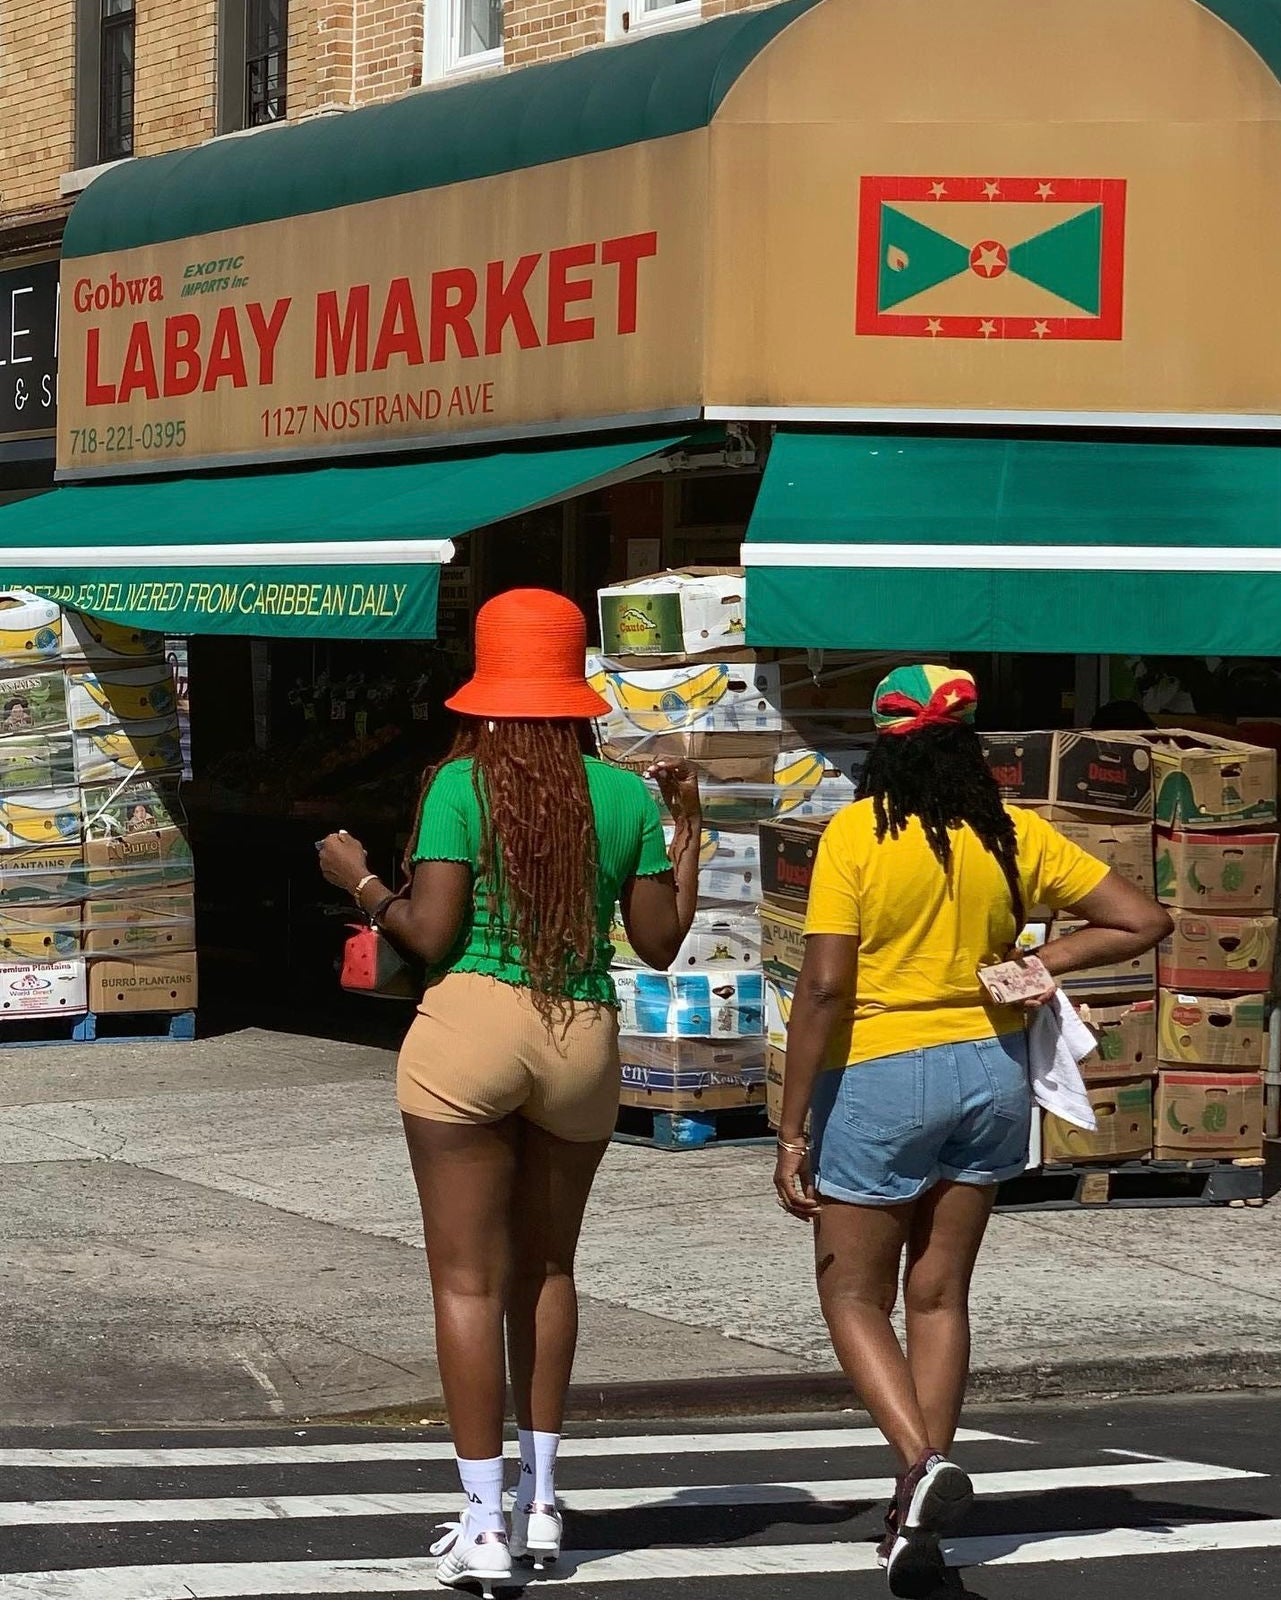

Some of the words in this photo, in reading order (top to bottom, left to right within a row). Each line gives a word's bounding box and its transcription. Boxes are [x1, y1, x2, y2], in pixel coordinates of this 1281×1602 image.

[183, 255, 245, 278] EXOTIC
[73, 271, 164, 313] Gobwa
[180, 275, 230, 298] IMPORTS
[0, 286, 34, 366] E
[85, 297, 292, 406] LABAY
[314, 231, 657, 379] MARKET
[14, 377, 29, 411] &
[41, 373, 59, 408] S
[261, 405, 307, 438] 1127
[313, 389, 442, 433] NOSTRAND
[447, 382, 494, 417] AVE
[70, 420, 187, 455] 718-221-0395
[2, 583, 97, 610] ABLES
[93, 582, 184, 612] DELIVERED
[183, 583, 238, 616] FROM
[238, 582, 347, 616] CARIBBEAN
[349, 583, 408, 617] DAILY
[32, 963, 72, 972] Plantains
[101, 977, 137, 988] BURRO
[138, 974, 193, 987] PLANTAINS
